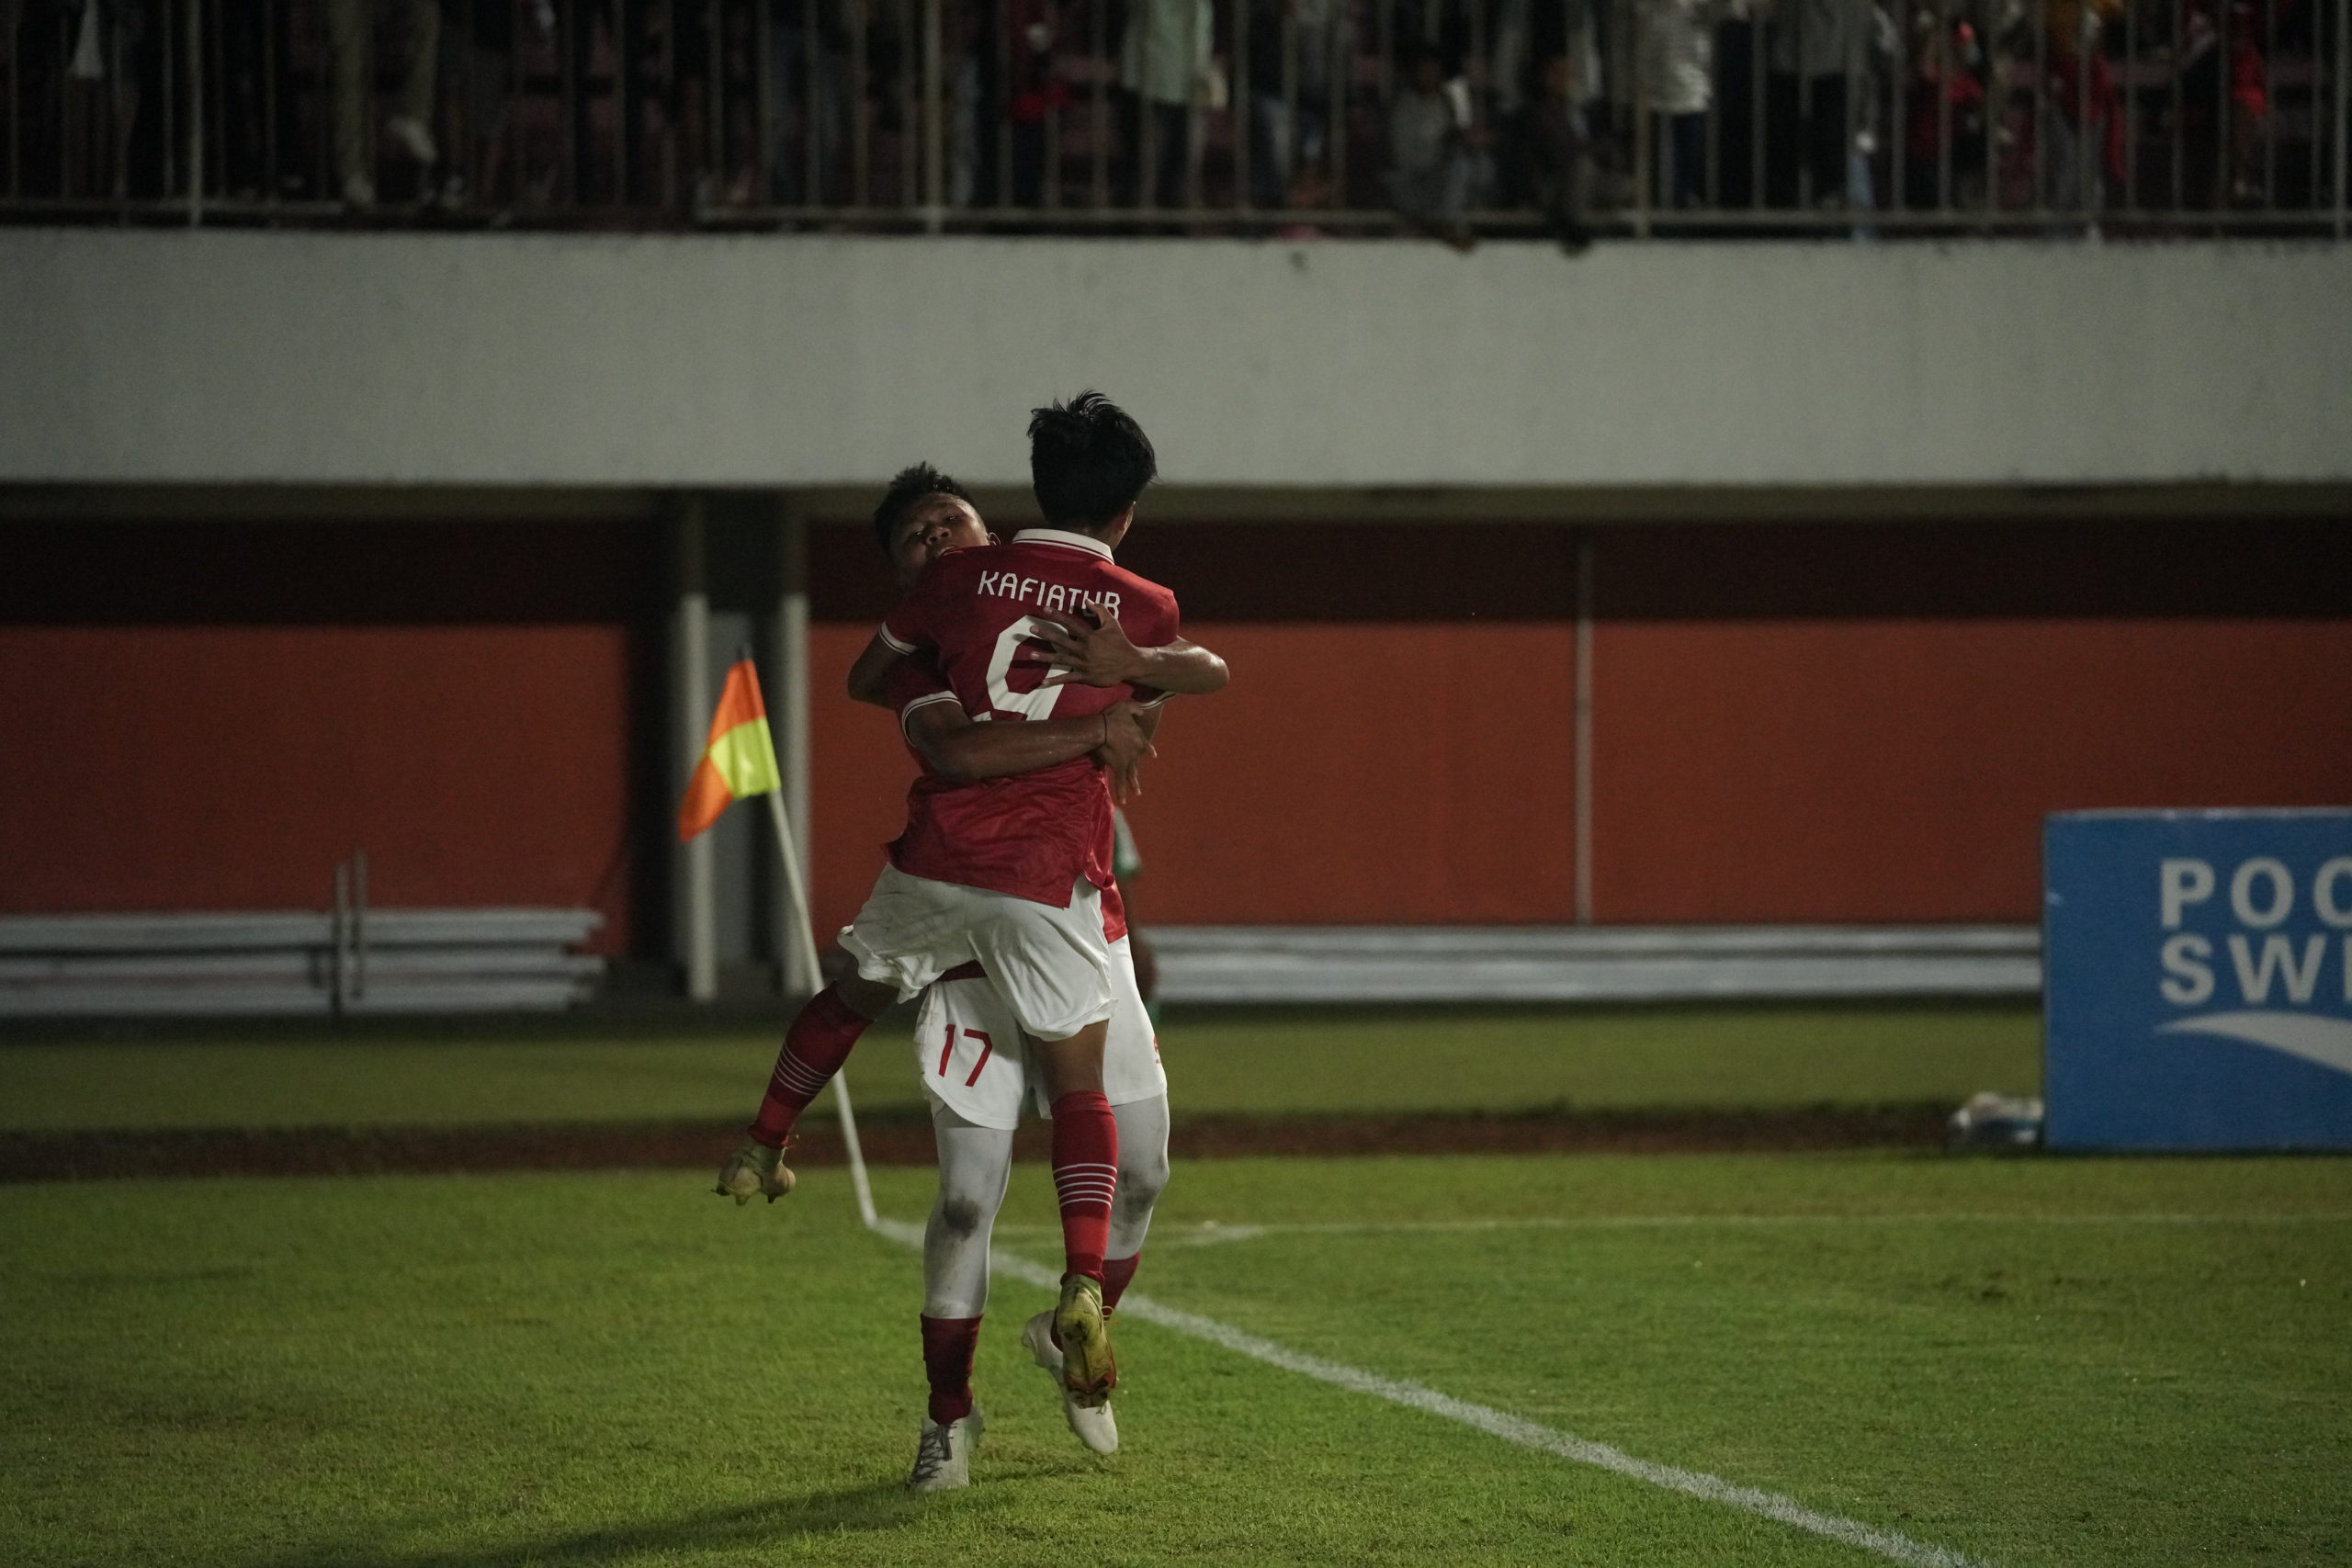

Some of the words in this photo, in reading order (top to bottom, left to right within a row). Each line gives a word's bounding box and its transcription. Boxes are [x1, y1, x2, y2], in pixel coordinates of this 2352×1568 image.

[977, 570, 1121, 620] KAFIATUR
[973, 615, 1075, 722] 9
[938, 1023, 993, 1087] 17
